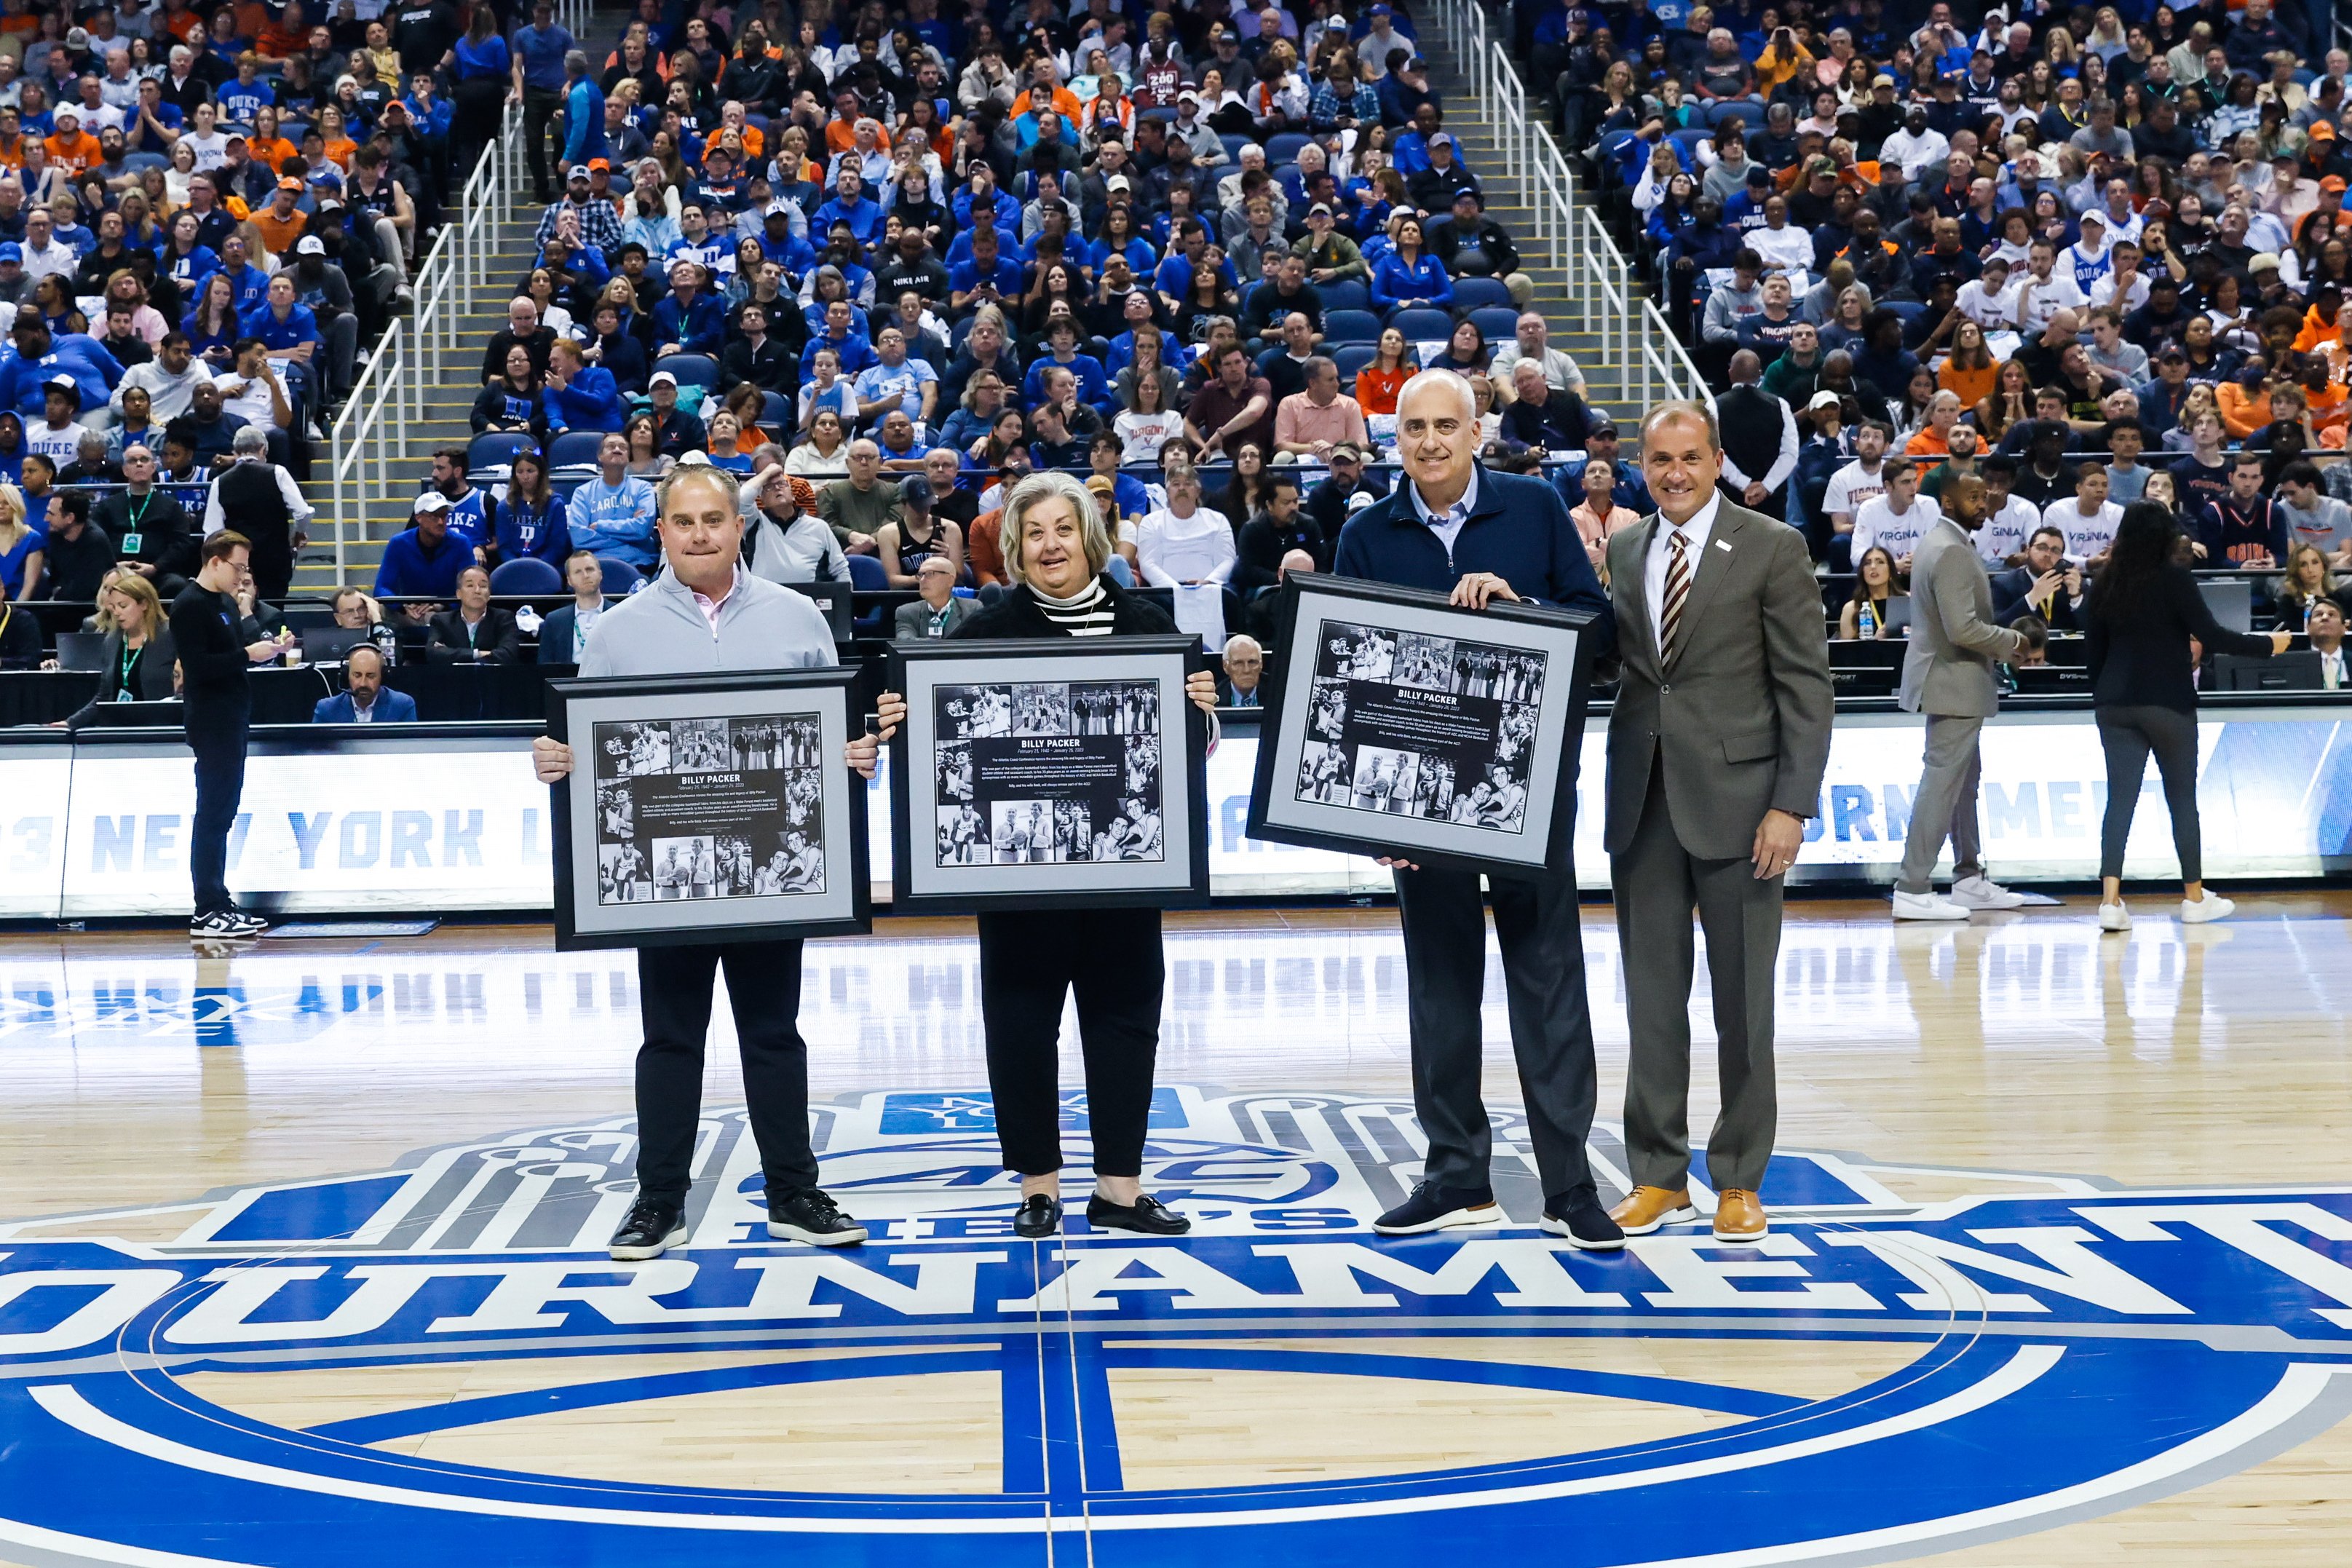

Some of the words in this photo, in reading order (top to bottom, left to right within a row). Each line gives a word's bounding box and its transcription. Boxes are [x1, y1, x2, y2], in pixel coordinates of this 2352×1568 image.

[228, 96, 259, 111] DUKE
[680, 116, 699, 129] KE
[1738, 214, 1767, 227] OYAL
[892, 276, 914, 286] NIKE
[914, 274, 930, 284] AIR
[2075, 266, 2103, 282] DUK
[1760, 325, 1793, 335] VIRGIN
[32, 441, 73, 456] DUKE
[590, 495, 635, 514] CAROLINA
[446, 512, 478, 528] UKE
[1991, 526, 2022, 537] GINIA
[1398, 689, 1422, 700] BILLY
[1423, 693, 1457, 705] PACKER
[1021, 740, 1044, 748] BILLY
[1047, 739, 1080, 747] PACKER
[681, 775, 705, 785] BILLY
[707, 774, 740, 783] PACKER
[9, 816, 54, 874] 3
[287, 808, 484, 870] YORK
[0, 1202, 2352, 1356] OURNAMENT
